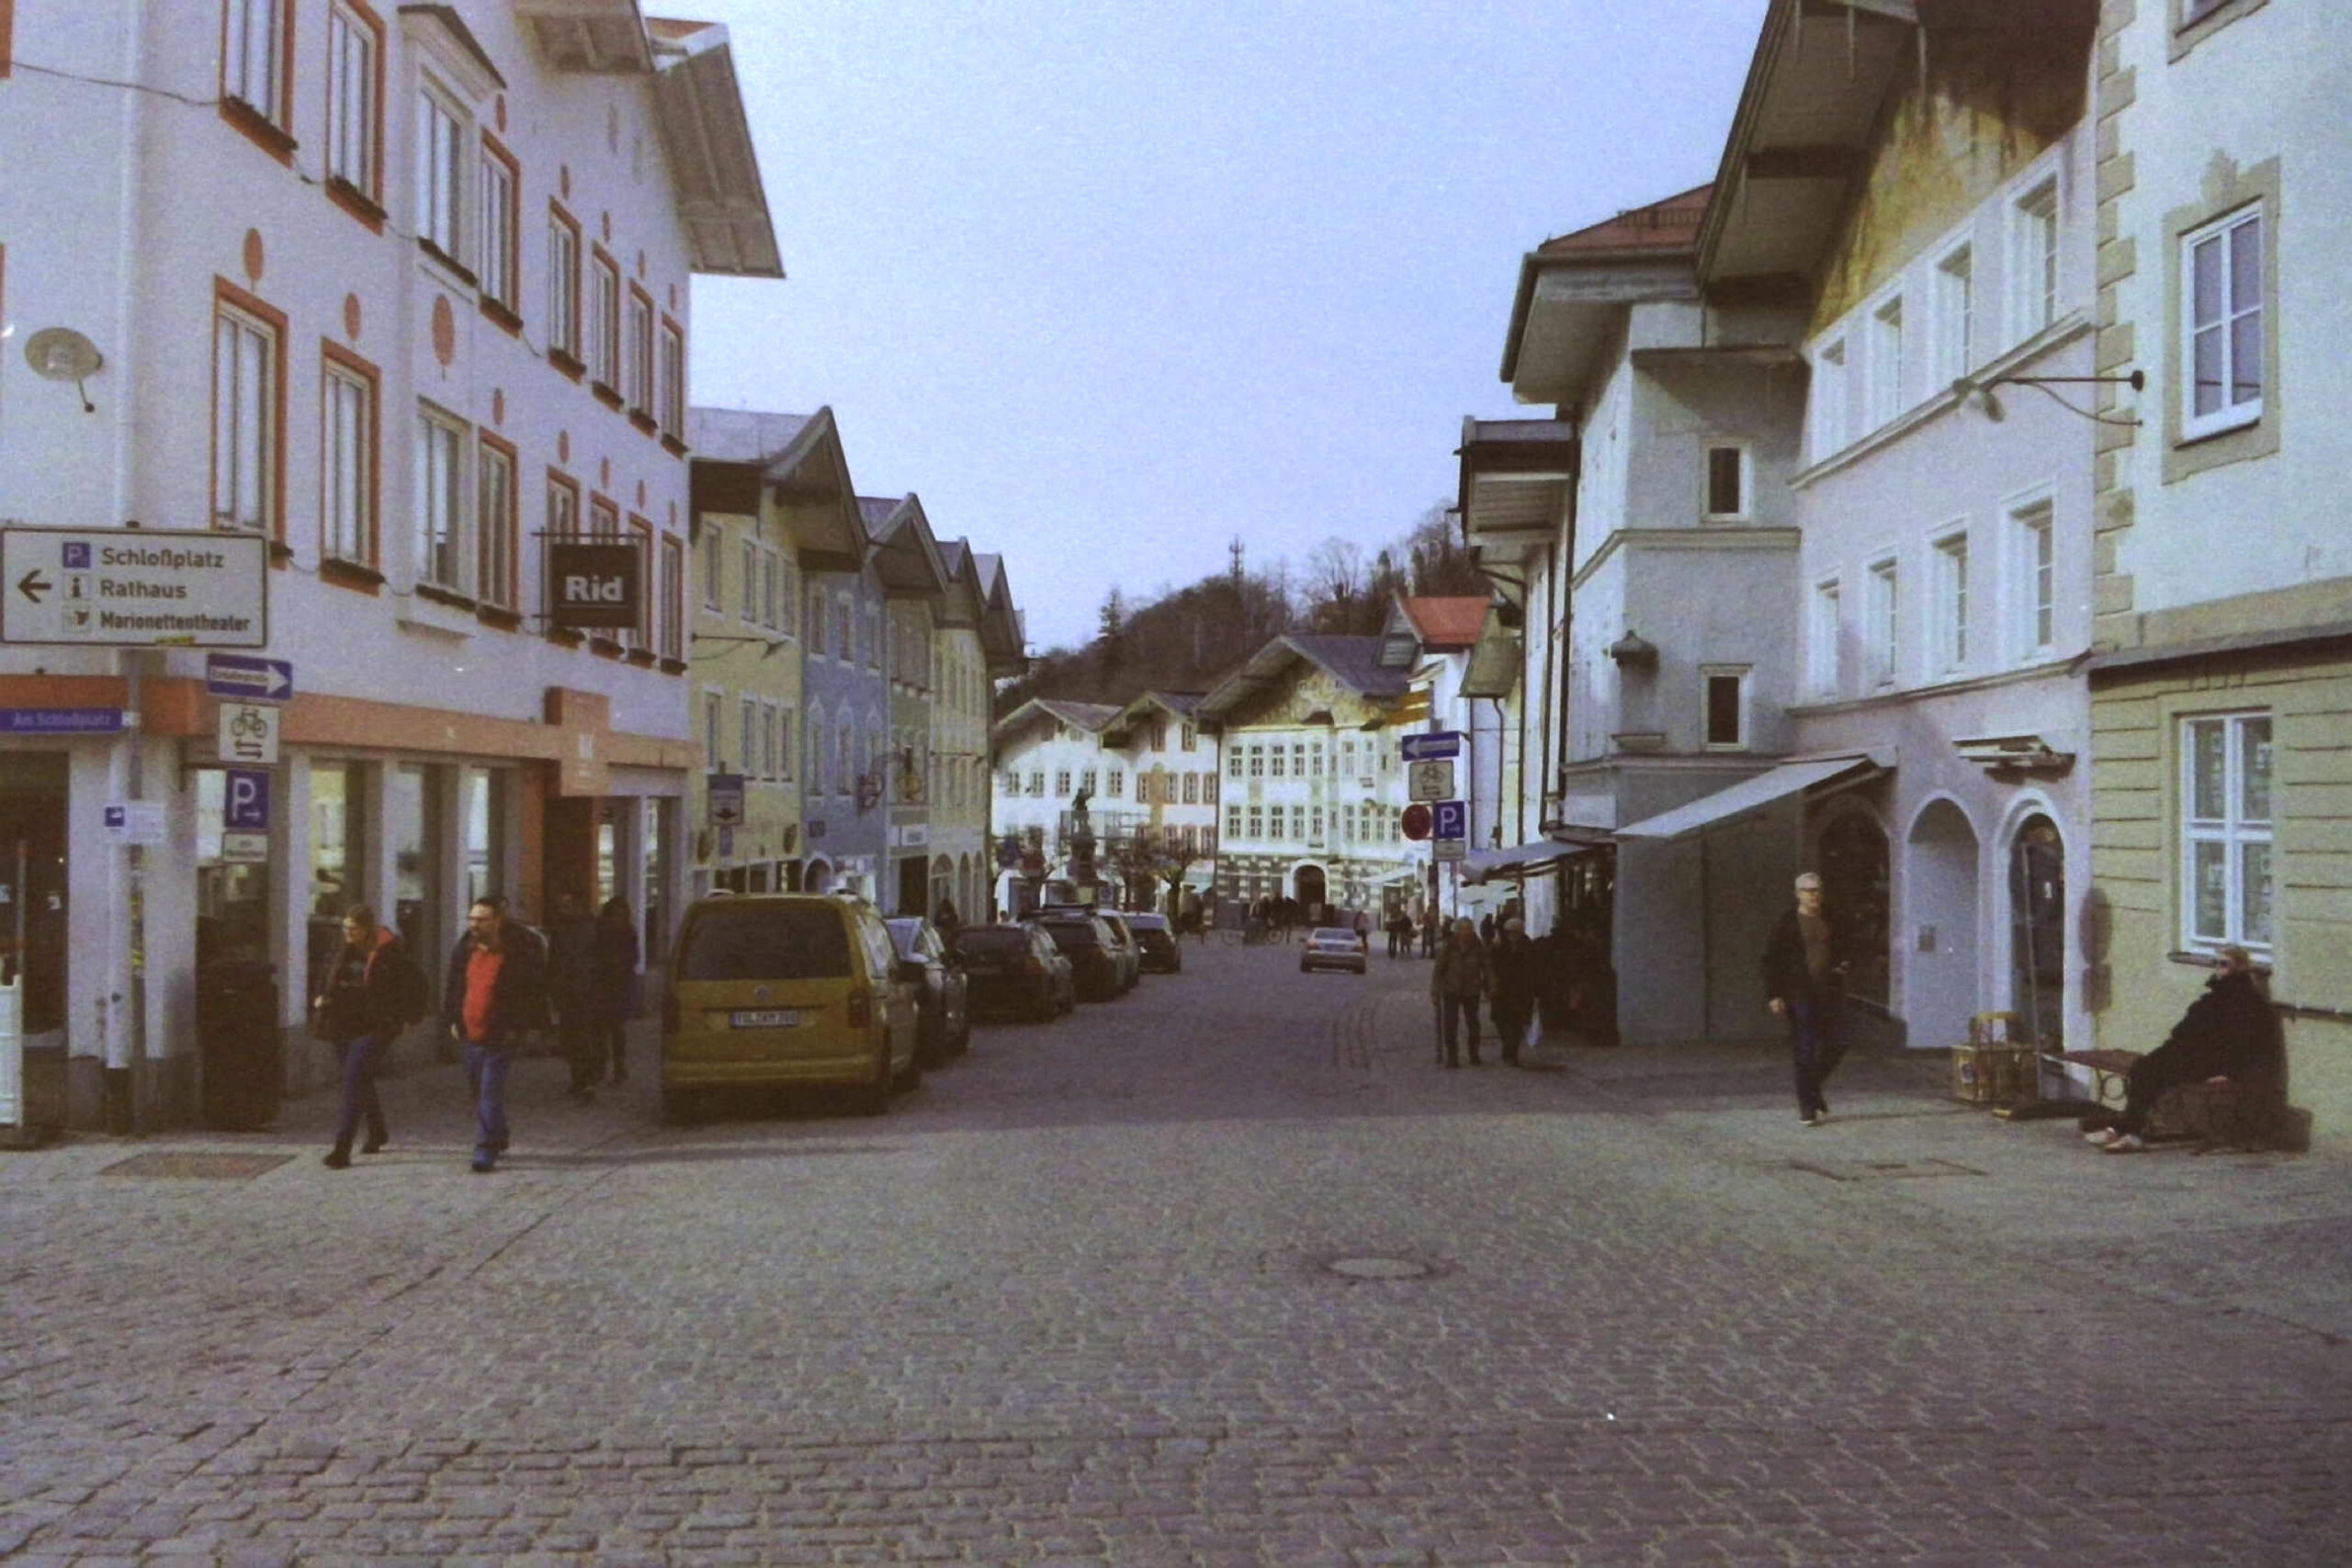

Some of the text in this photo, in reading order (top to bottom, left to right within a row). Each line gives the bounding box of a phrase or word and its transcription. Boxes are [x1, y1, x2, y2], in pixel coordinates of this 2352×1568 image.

[101, 547, 225, 569] Schloßplatz
[100, 579, 187, 598] Rathaus
[565, 575, 624, 601] Rid
[100, 610, 251, 631] Marionettentheater
[232, 778, 255, 820] P
[1439, 807, 1457, 835] P
